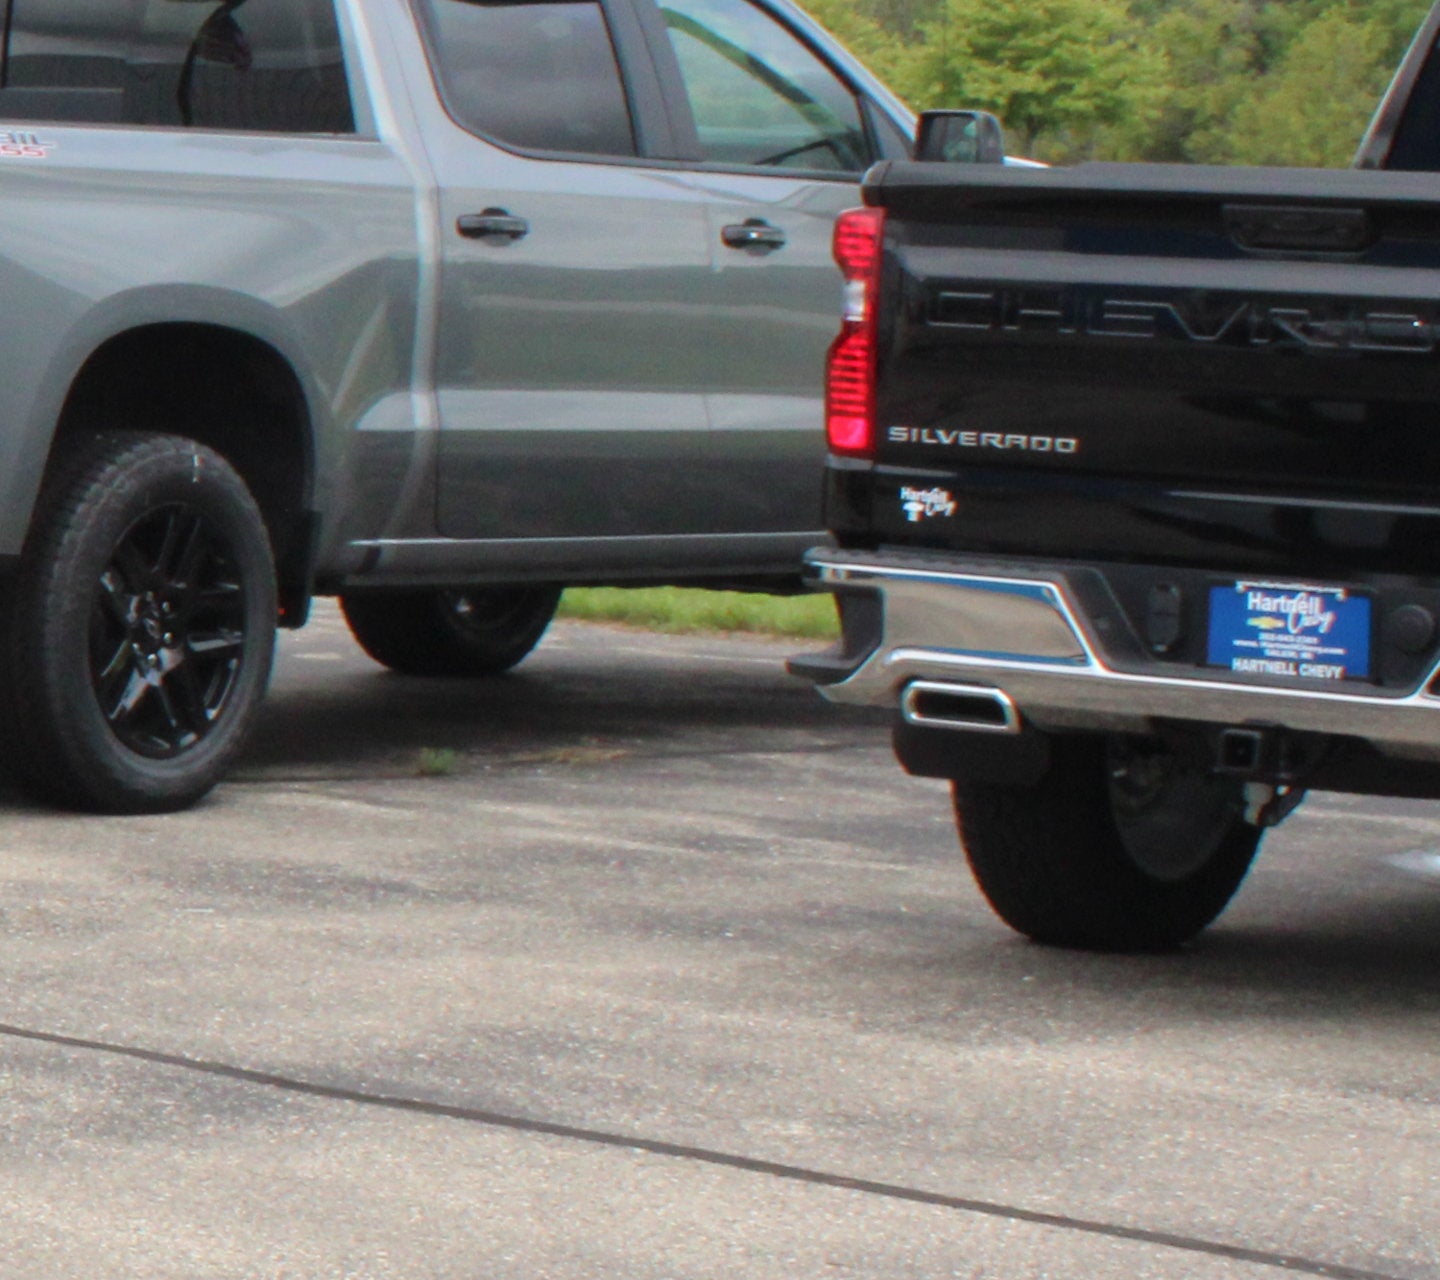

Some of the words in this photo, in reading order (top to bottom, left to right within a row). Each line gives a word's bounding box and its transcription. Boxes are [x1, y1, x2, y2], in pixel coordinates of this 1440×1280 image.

[888, 426, 1079, 454] SILVERADO
[1232, 658, 1298, 675] HARTNELL
[1299, 663, 1346, 679] CHEVY
